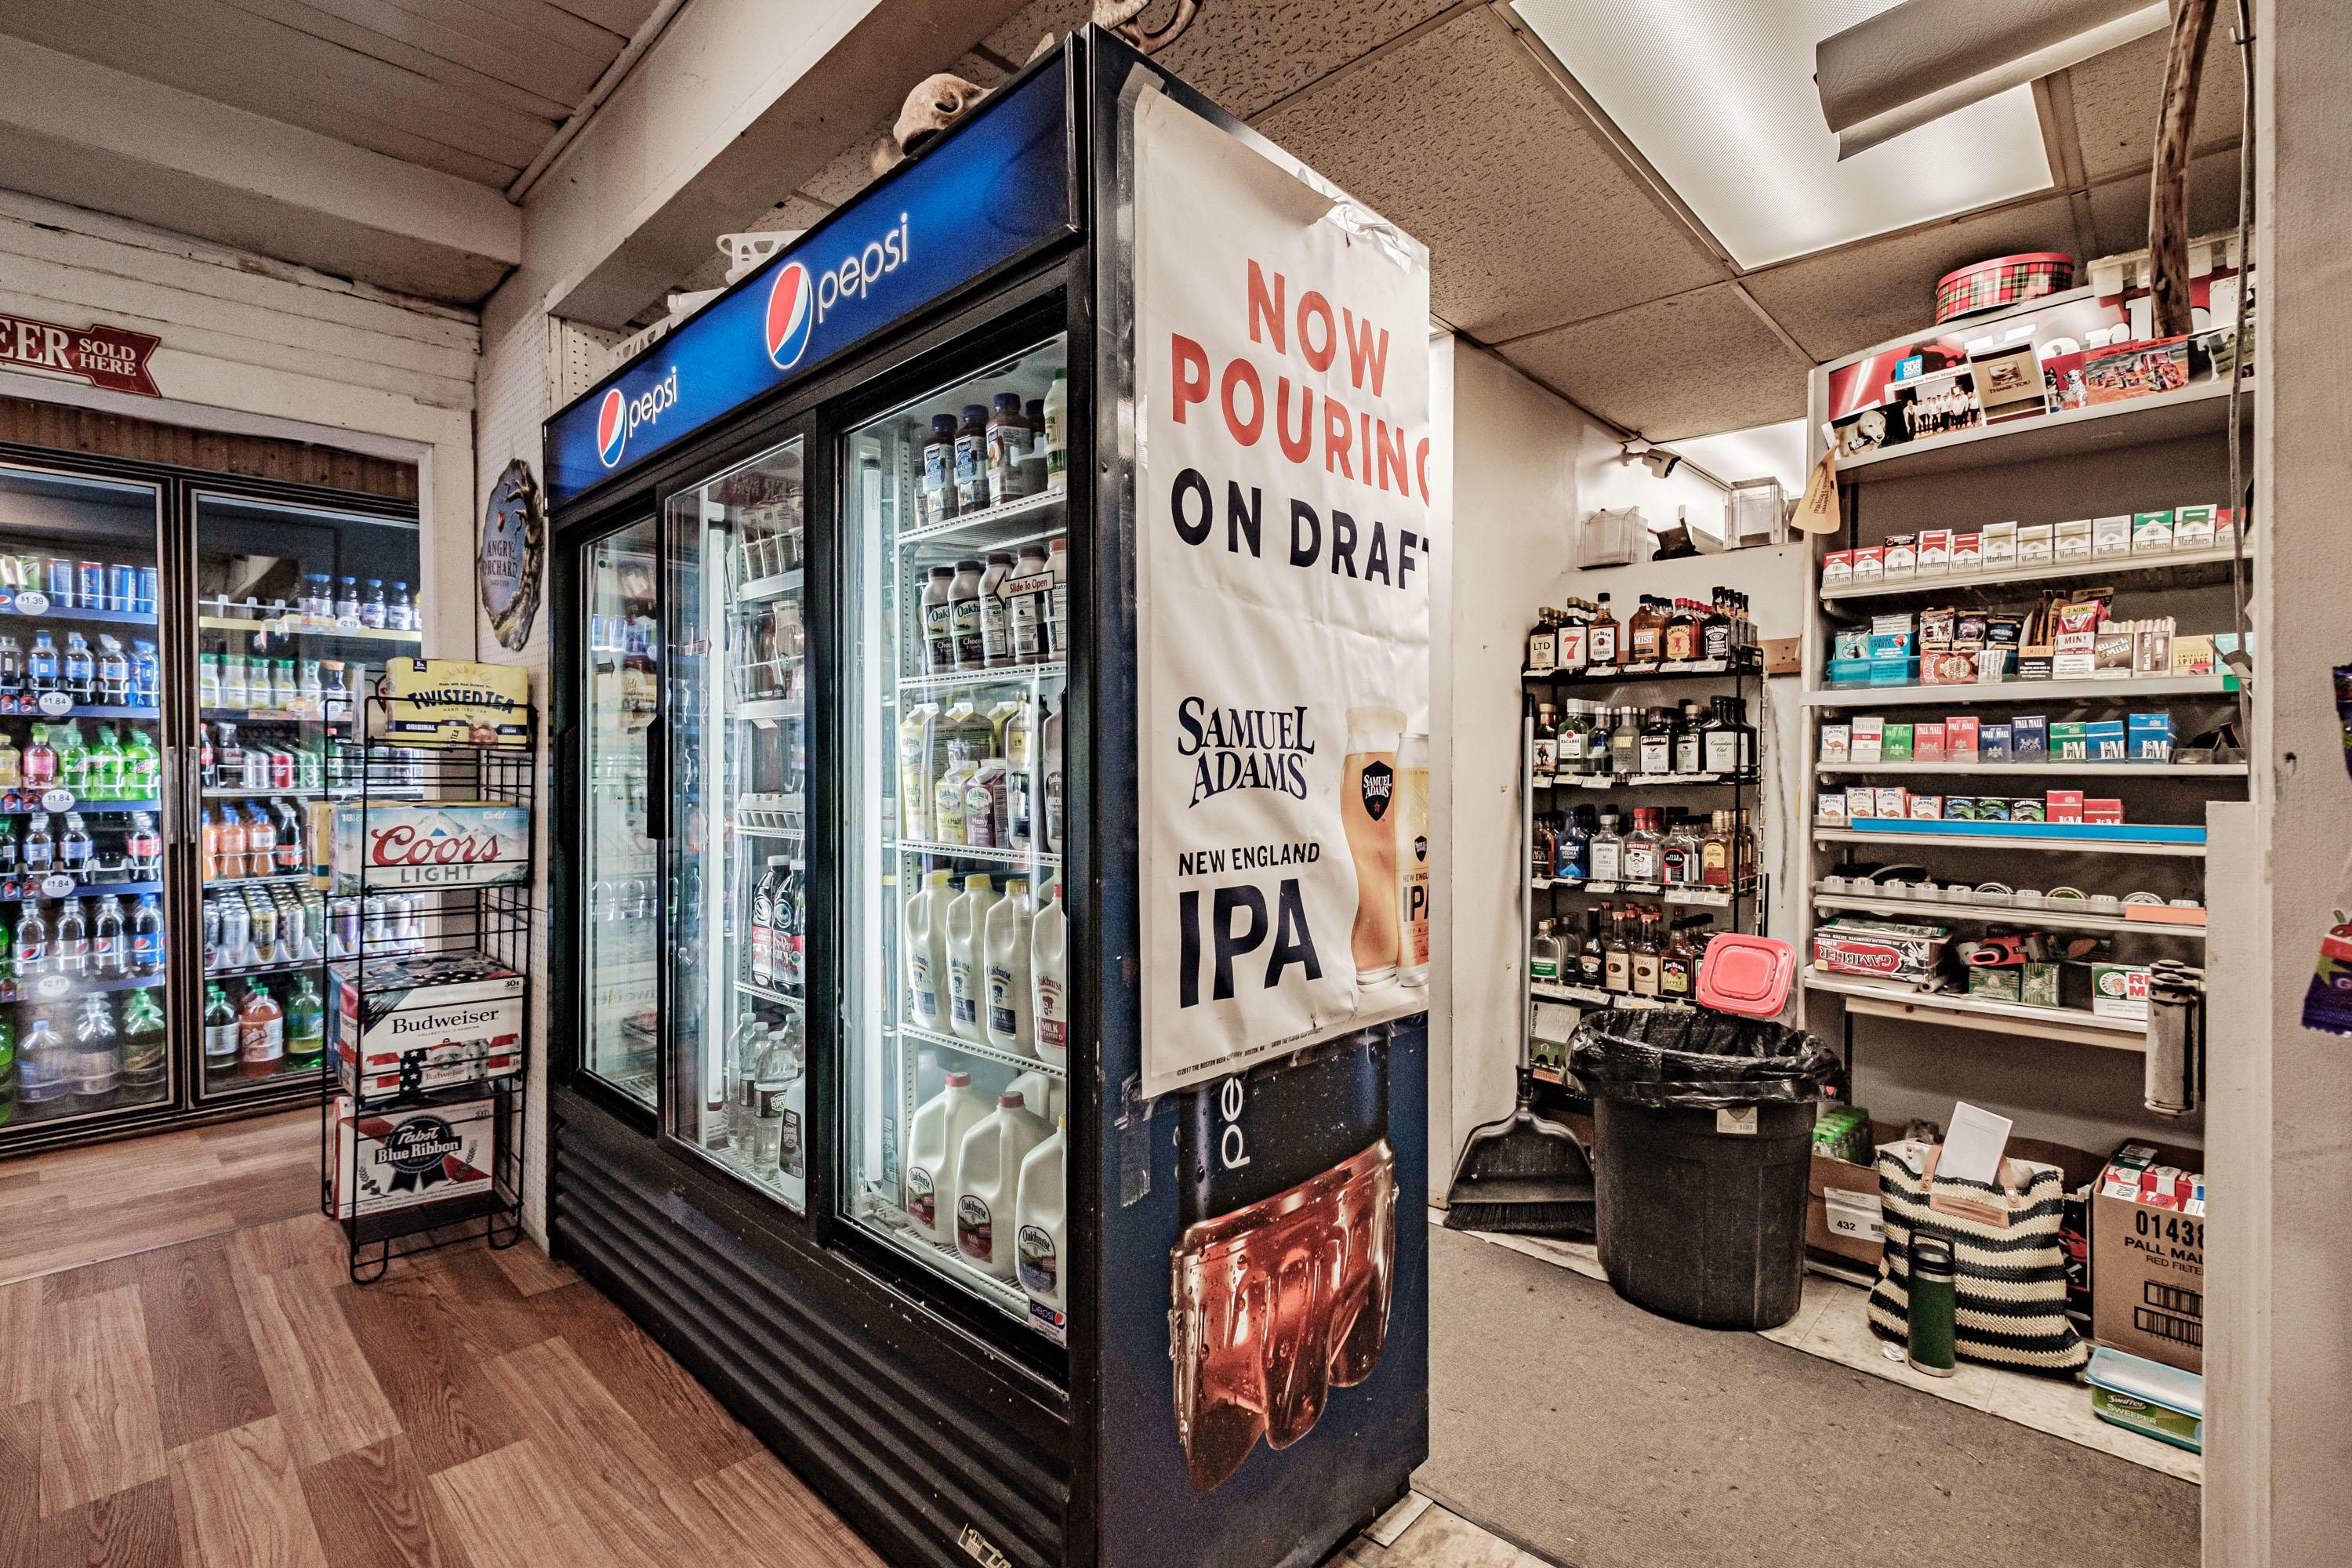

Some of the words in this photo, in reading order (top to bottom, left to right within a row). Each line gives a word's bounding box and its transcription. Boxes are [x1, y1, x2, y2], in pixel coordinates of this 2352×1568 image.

[818, 212, 909, 324] pepsi
[1247, 258, 1389, 397] NOW
[79, 338, 136, 361] SOLD
[80, 353, 136, 376] HERE
[1904, 363, 1921, 372] OUR
[1940, 369, 1959, 379] Hope's
[1988, 385, 2013, 394] THANK
[2014, 379, 2031, 389] YOU
[629, 366, 677, 438] pepsi
[1171, 468, 1261, 558] ON
[1290, 497, 1429, 590] DRAF
[2136, 539, 2170, 551] Marlboro
[2178, 534, 2209, 546] Marlboro
[486, 539, 515, 557] ANGRY
[2059, 546, 2088, 559] Marlboro
[2097, 543, 2125, 555] Marlboro
[1918, 557, 1947, 568] Marlboro
[1987, 551, 2013, 563] Marlboro
[2021, 550, 2049, 562] Marlboro
[481, 560, 517, 579] ORCHARD
[1886, 561, 1913, 572] Marlboro
[1951, 557, 1980, 570] Marlboro
[1824, 573, 1850, 583] Marlboro
[1854, 569, 1882, 580] Marlboro
[1010, 583, 1024, 593] Slide
[1024, 582, 1032, 590] To
[1032, 578, 1047, 590] Open
[21, 595, 44, 605] $1.39
[1668, 628, 1690, 637] FIREBALL
[1534, 642, 1551, 651] LTD
[1634, 636, 1653, 644] MIST
[2096, 637, 2129, 652] Black
[1564, 636, 1581, 659] 7
[2106, 644, 2130, 657] Mild
[44, 697, 67, 706] $1.84
[408, 688, 483, 710] TWISTED
[485, 691, 515, 714] TEA
[405, 723, 436, 731] ORIGINAL
[1178, 696, 1315, 756] SAMUEL
[2015, 719, 2028, 728] PALL
[2029, 717, 2043, 728] MALL
[1917, 726, 1929, 735] PALL
[1929, 726, 1943, 735] MALL
[1982, 730, 1994, 739] PALL
[1996, 730, 2009, 739] MALL
[2063, 741, 2086, 759] L&M
[2100, 740, 2125, 759] L&M
[2142, 739, 2168, 759] L&M
[1189, 751, 1307, 808] ADAMS
[1363, 774, 1392, 787] SAMUEL
[48, 793, 70, 802] $1.84
[1365, 786, 1389, 798] ADAMS
[1947, 799, 1973, 808] CAMEL
[1980, 800, 2005, 808] CAMEL
[2014, 800, 2042, 809] CAMEL
[341, 813, 353, 822] 18
[482, 810, 506, 820] Cold
[971, 817, 988, 826] Heavy
[371, 825, 502, 866] Coors
[1178, 849, 1225, 877] NEW
[1232, 842, 1320, 870] ENGLAND
[401, 865, 475, 884] LIGHT
[1403, 873, 1414, 882] NEW
[47, 880, 70, 888] $1.84
[1179, 878, 1323, 1009] IPA
[1819, 945, 1894, 967] GAMBLER
[1671, 962, 1685, 972] BEAM
[391, 1010, 499, 1034] Budweiser
[1041, 1022, 1058, 1033] MILK
[1200, 1060, 1216, 1069] BOSTON
[1271, 1040, 1282, 1048] SAVOR
[426, 1068, 465, 1080] Budweiser
[397, 1124, 441, 1145] Pabst
[377, 1147, 409, 1163] Blue
[412, 1139, 459, 1157] Ribbon
[909, 1170, 930, 1189] Oakhurst
[961, 1199, 986, 1219] Oakhurst
[1837, 1220, 1856, 1232] 432
[967, 1233, 978, 1243] Milk
[1022, 1229, 1051, 1252] Oakhurst
[2125, 1236, 2165, 1256] PALL
[2147, 1255, 2169, 1267] RED
[1031, 1303, 1054, 1321] pepsi
[2108, 1395, 2144, 1408] Swiffer
[2107, 1403, 2157, 1425] SWEEPER
